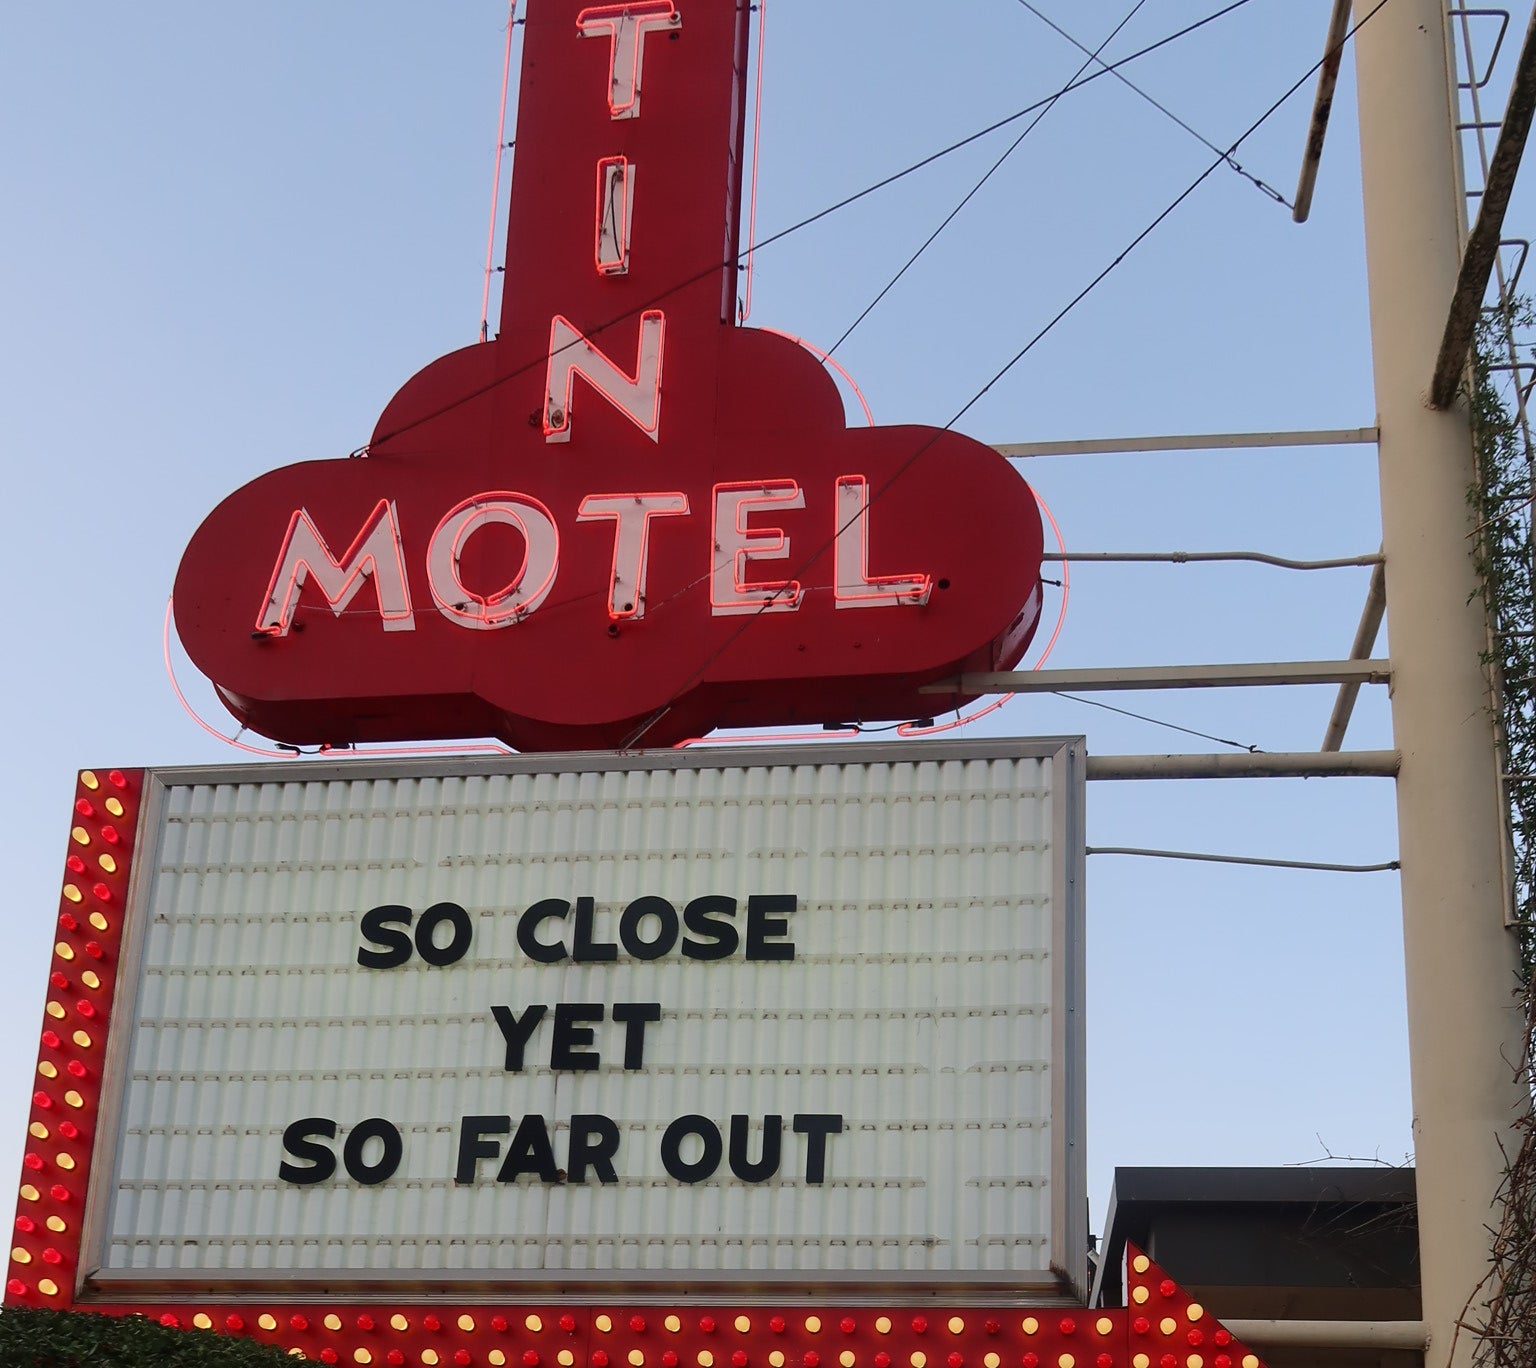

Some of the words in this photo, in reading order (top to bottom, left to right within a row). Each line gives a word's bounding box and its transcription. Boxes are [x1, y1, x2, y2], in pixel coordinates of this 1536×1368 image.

[253, 474, 934, 638] MOTEL
[357, 902, 473, 969] SO
[516, 894, 798, 964] CLOSE
[490, 1003, 661, 1071] YET
[279, 1117, 403, 1185] SO
[456, 1114, 620, 1184] FAR
[660, 1114, 843, 1184] OUT
